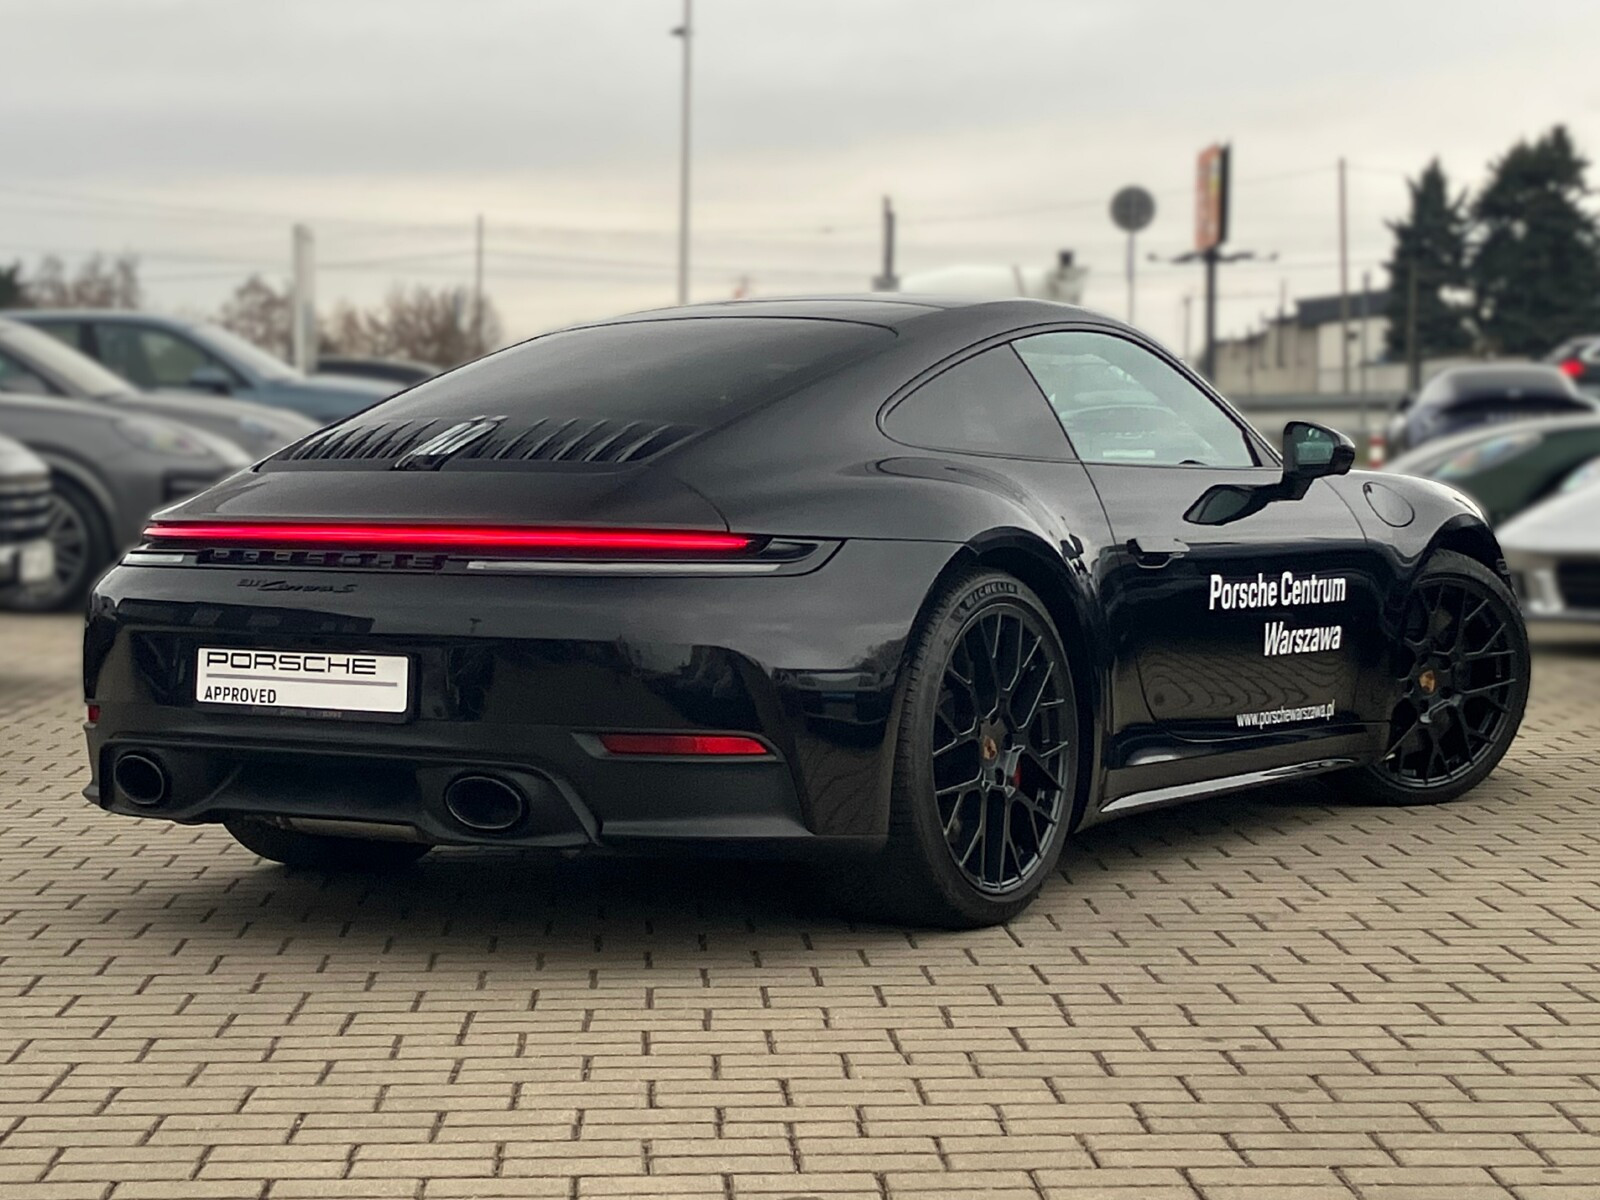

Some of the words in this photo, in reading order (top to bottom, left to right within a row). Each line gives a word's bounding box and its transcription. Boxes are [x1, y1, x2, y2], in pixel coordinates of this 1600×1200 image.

[211, 548, 437, 571] PORSCHE
[962, 582, 1017, 607] MICHELIN
[1208, 572, 1278, 610] Porsche
[1280, 571, 1347, 607] Centrum
[1264, 621, 1342, 657] Warszawa
[206, 651, 377, 675] PORSCHE
[204, 686, 277, 704] APPROVED
[1236, 698, 1336, 730] www.porschewarszawa.pl
